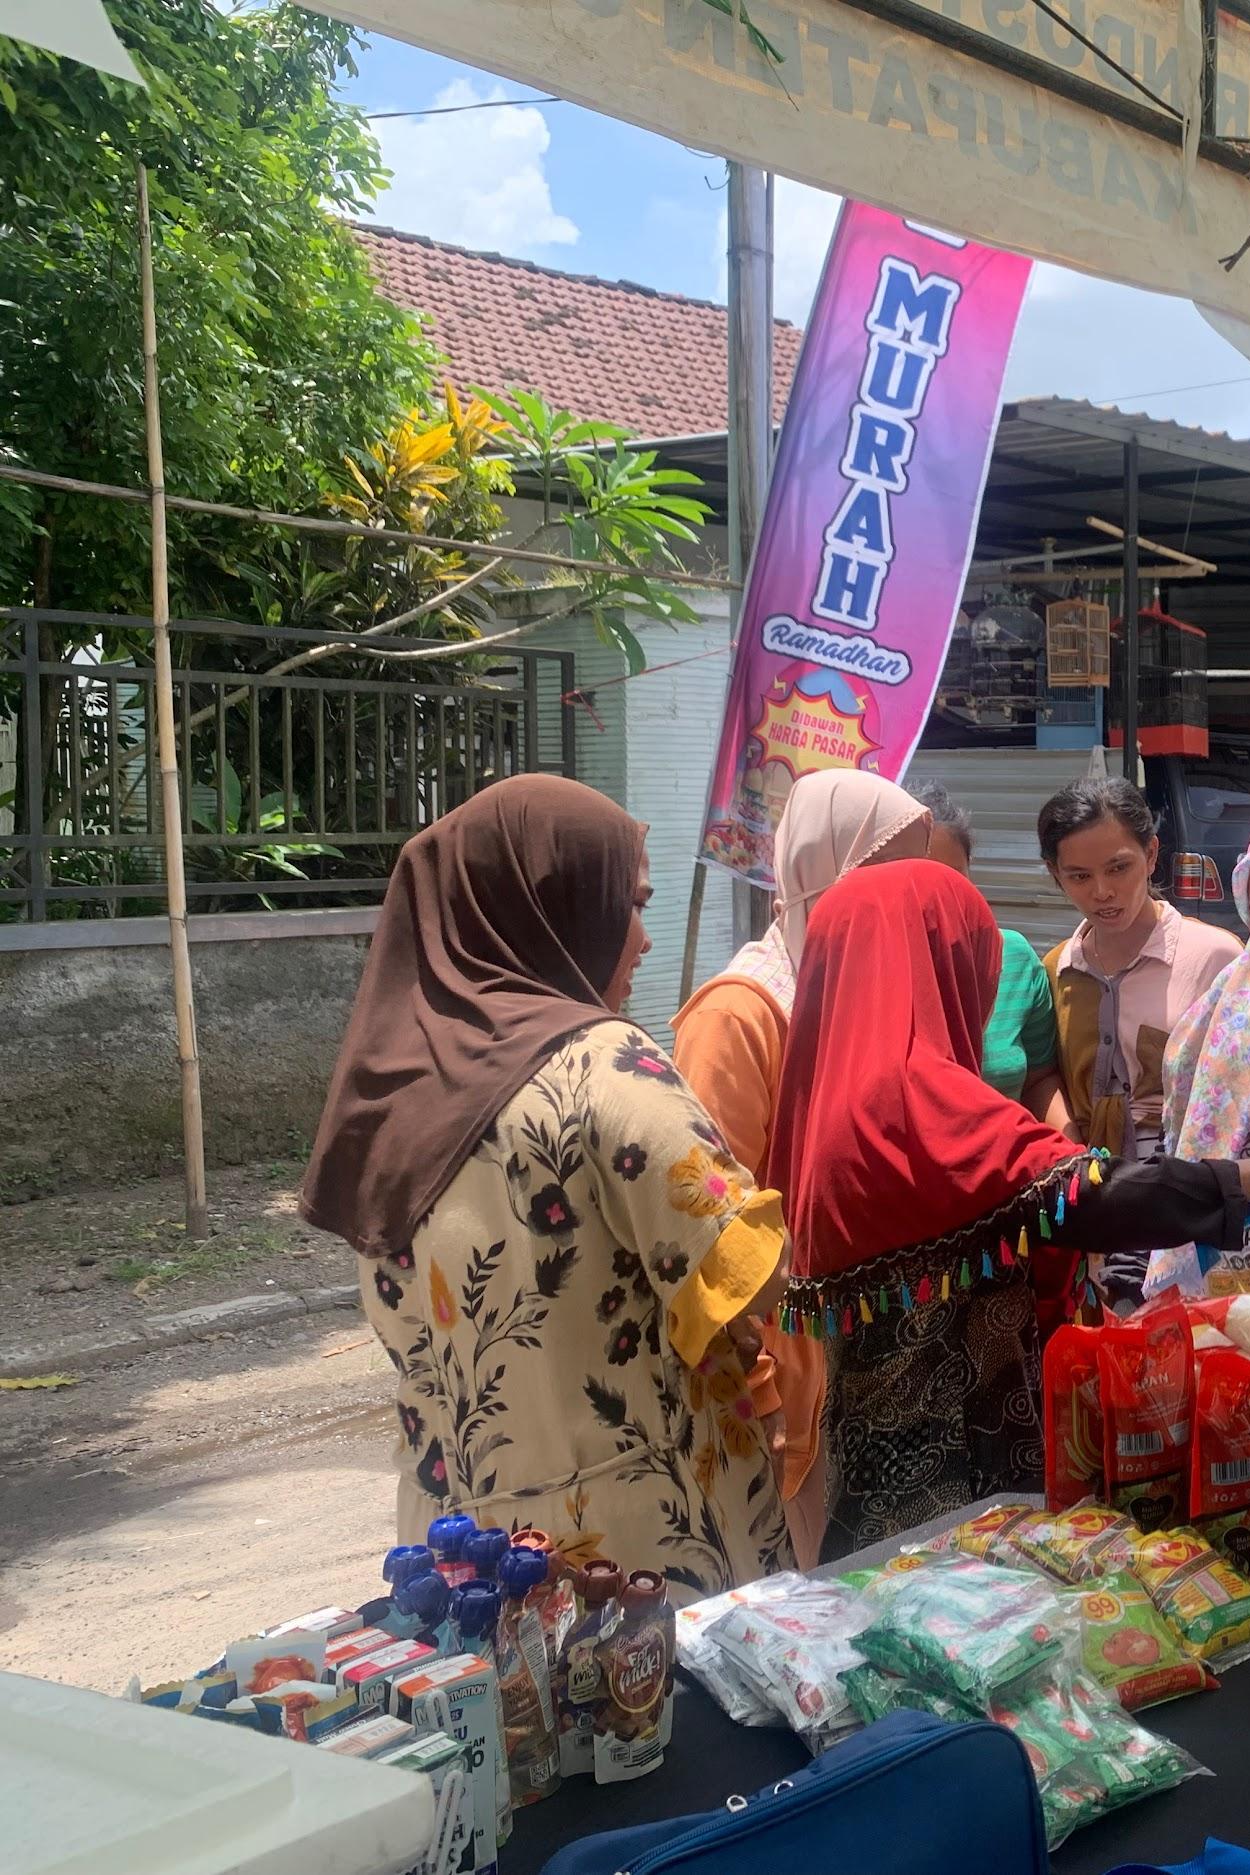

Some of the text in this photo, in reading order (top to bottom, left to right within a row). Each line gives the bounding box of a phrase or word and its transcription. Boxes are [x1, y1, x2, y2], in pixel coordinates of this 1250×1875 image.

[817, 263, 955, 624] MURAH
[769, 622, 902, 677] Ramadhan
[768, 721, 857, 761] HARGA PASAR
